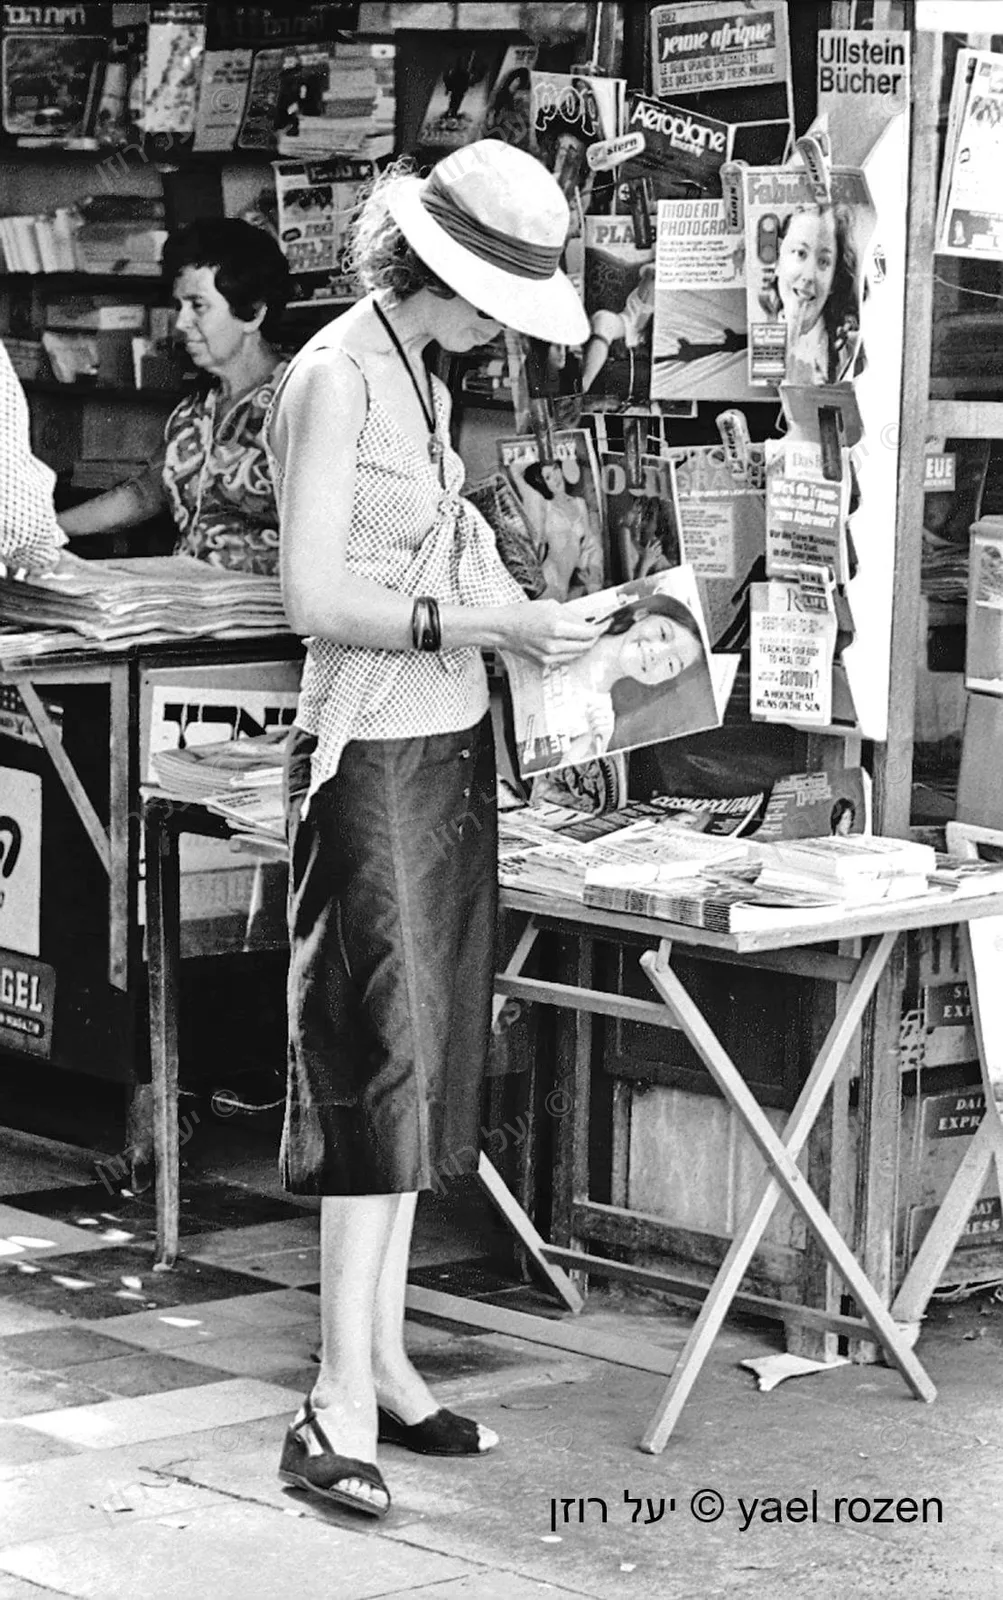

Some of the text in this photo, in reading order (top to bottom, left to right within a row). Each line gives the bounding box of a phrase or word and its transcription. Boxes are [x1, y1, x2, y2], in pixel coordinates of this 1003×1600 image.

[820, 37, 906, 65] Ullstein
[820, 66, 900, 95] Bücher
[631, 101, 727, 153] Aeroplane
[606, 138, 638, 156] stern
[956, 1097, 982, 1111] DAI
[938, 1115, 981, 1131] EXPR
